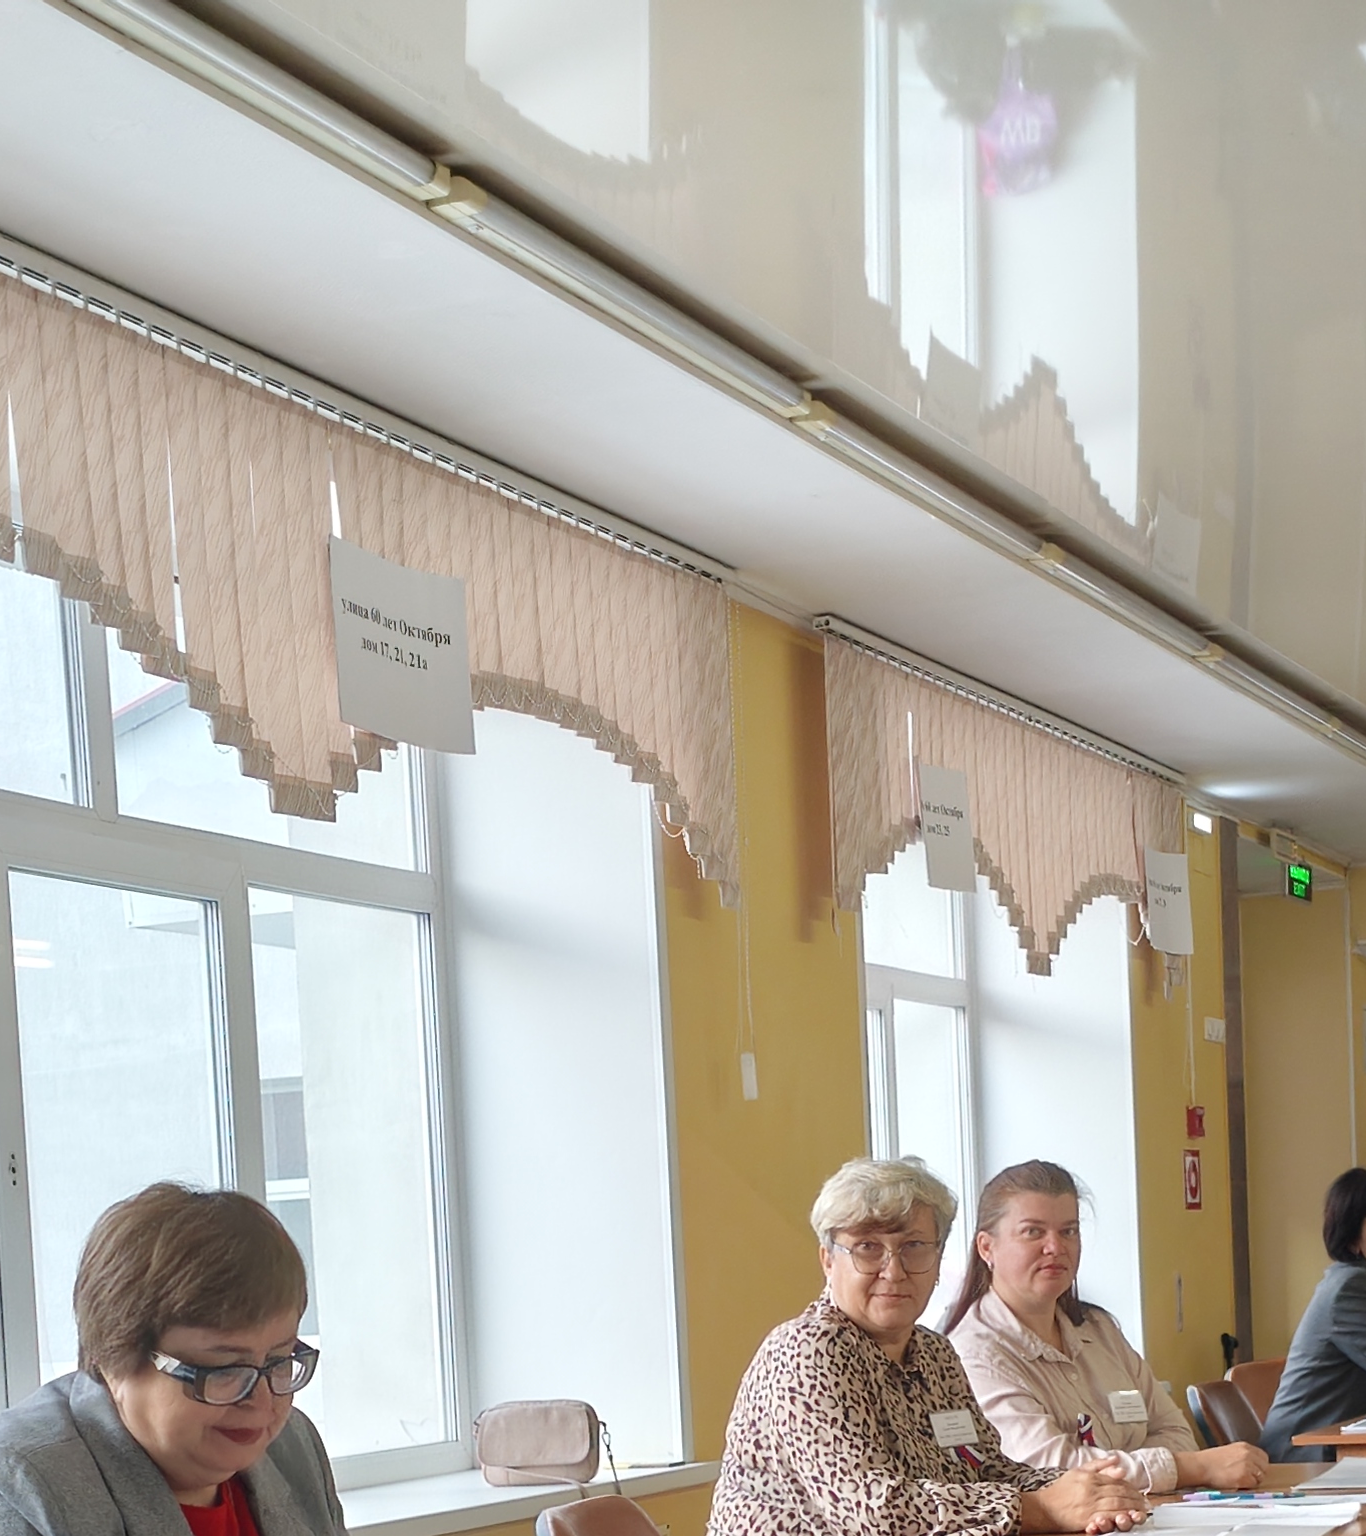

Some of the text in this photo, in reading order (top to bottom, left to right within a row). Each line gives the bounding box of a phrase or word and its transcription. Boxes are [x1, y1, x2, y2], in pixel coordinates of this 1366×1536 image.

[341, 598, 452, 648] улица 60 лет Октября
[361, 637, 428, 670] дом 17, 21, 21а
